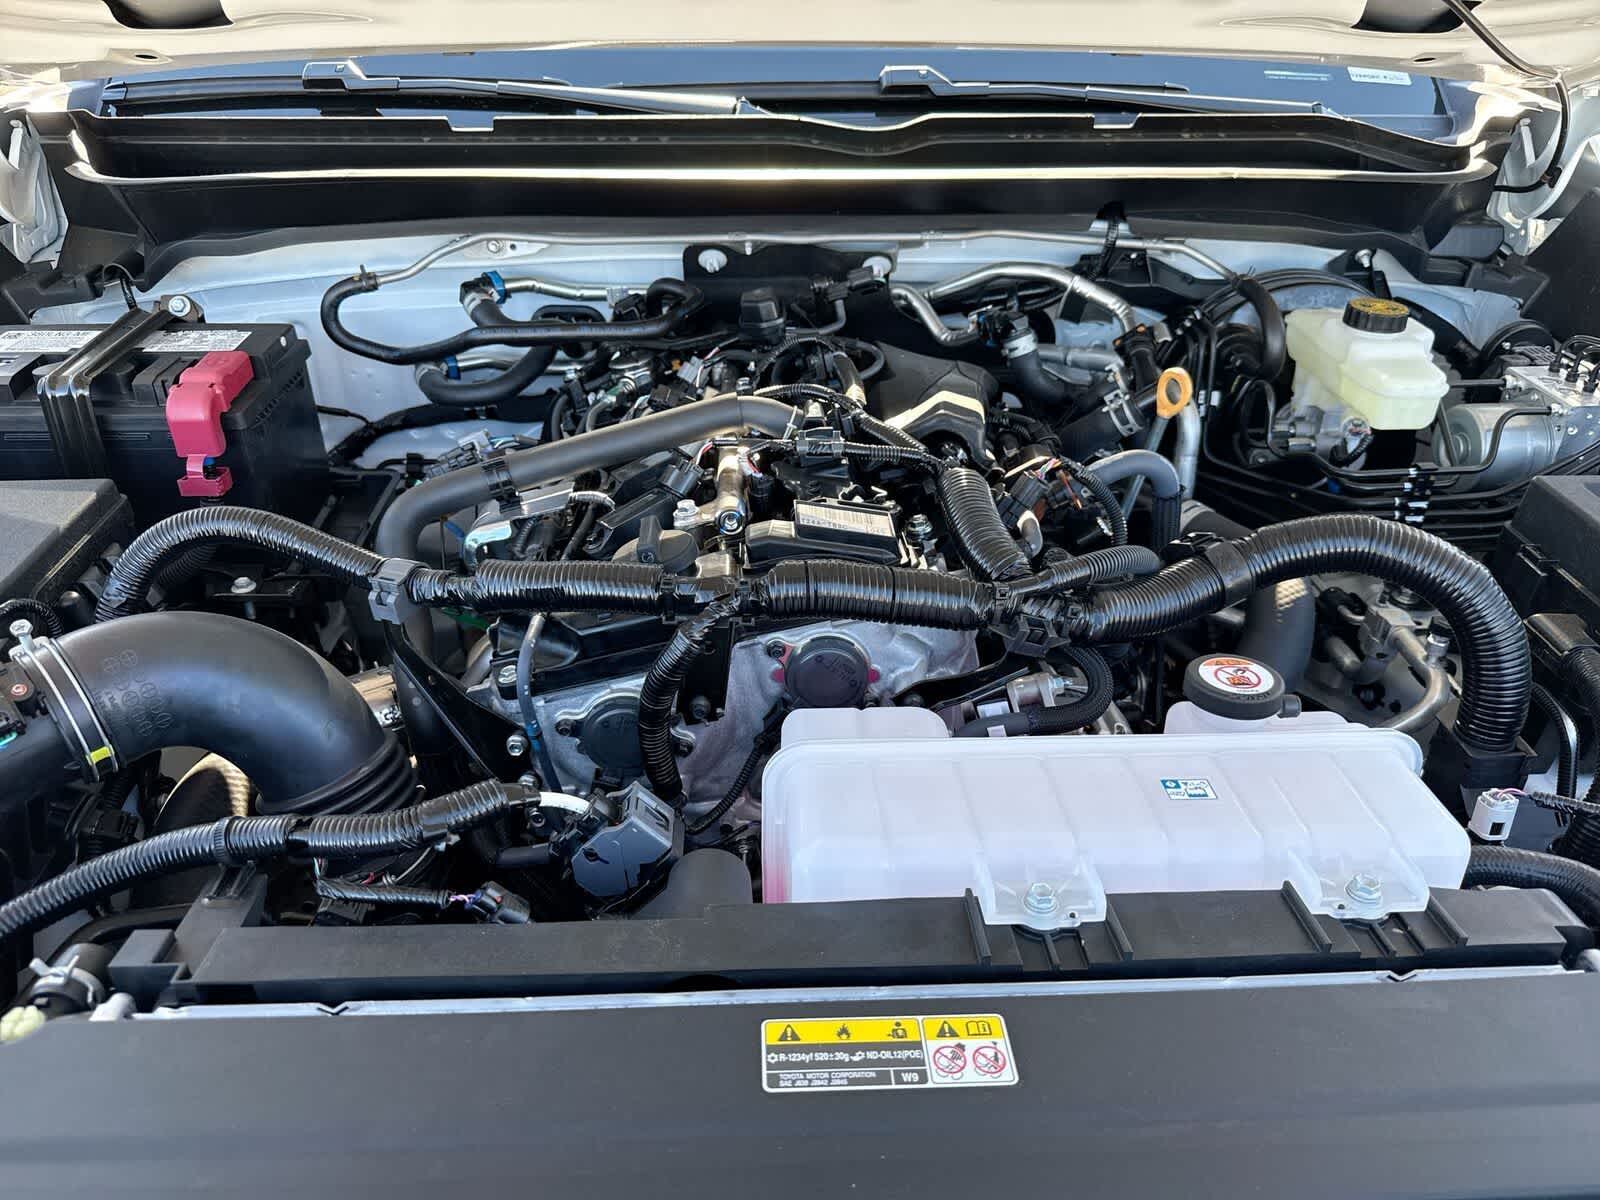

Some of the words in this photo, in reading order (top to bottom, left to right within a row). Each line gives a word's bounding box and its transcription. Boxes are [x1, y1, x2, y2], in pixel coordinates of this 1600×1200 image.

[779, 1051, 813, 1063] R-1234yf
[866, 1049, 924, 1060] ND-OIL12(POE)
[779, 1072, 804, 1080] TOYOTA
[831, 1071, 876, 1079] CORPORATION
[901, 1072, 919, 1082] W9
